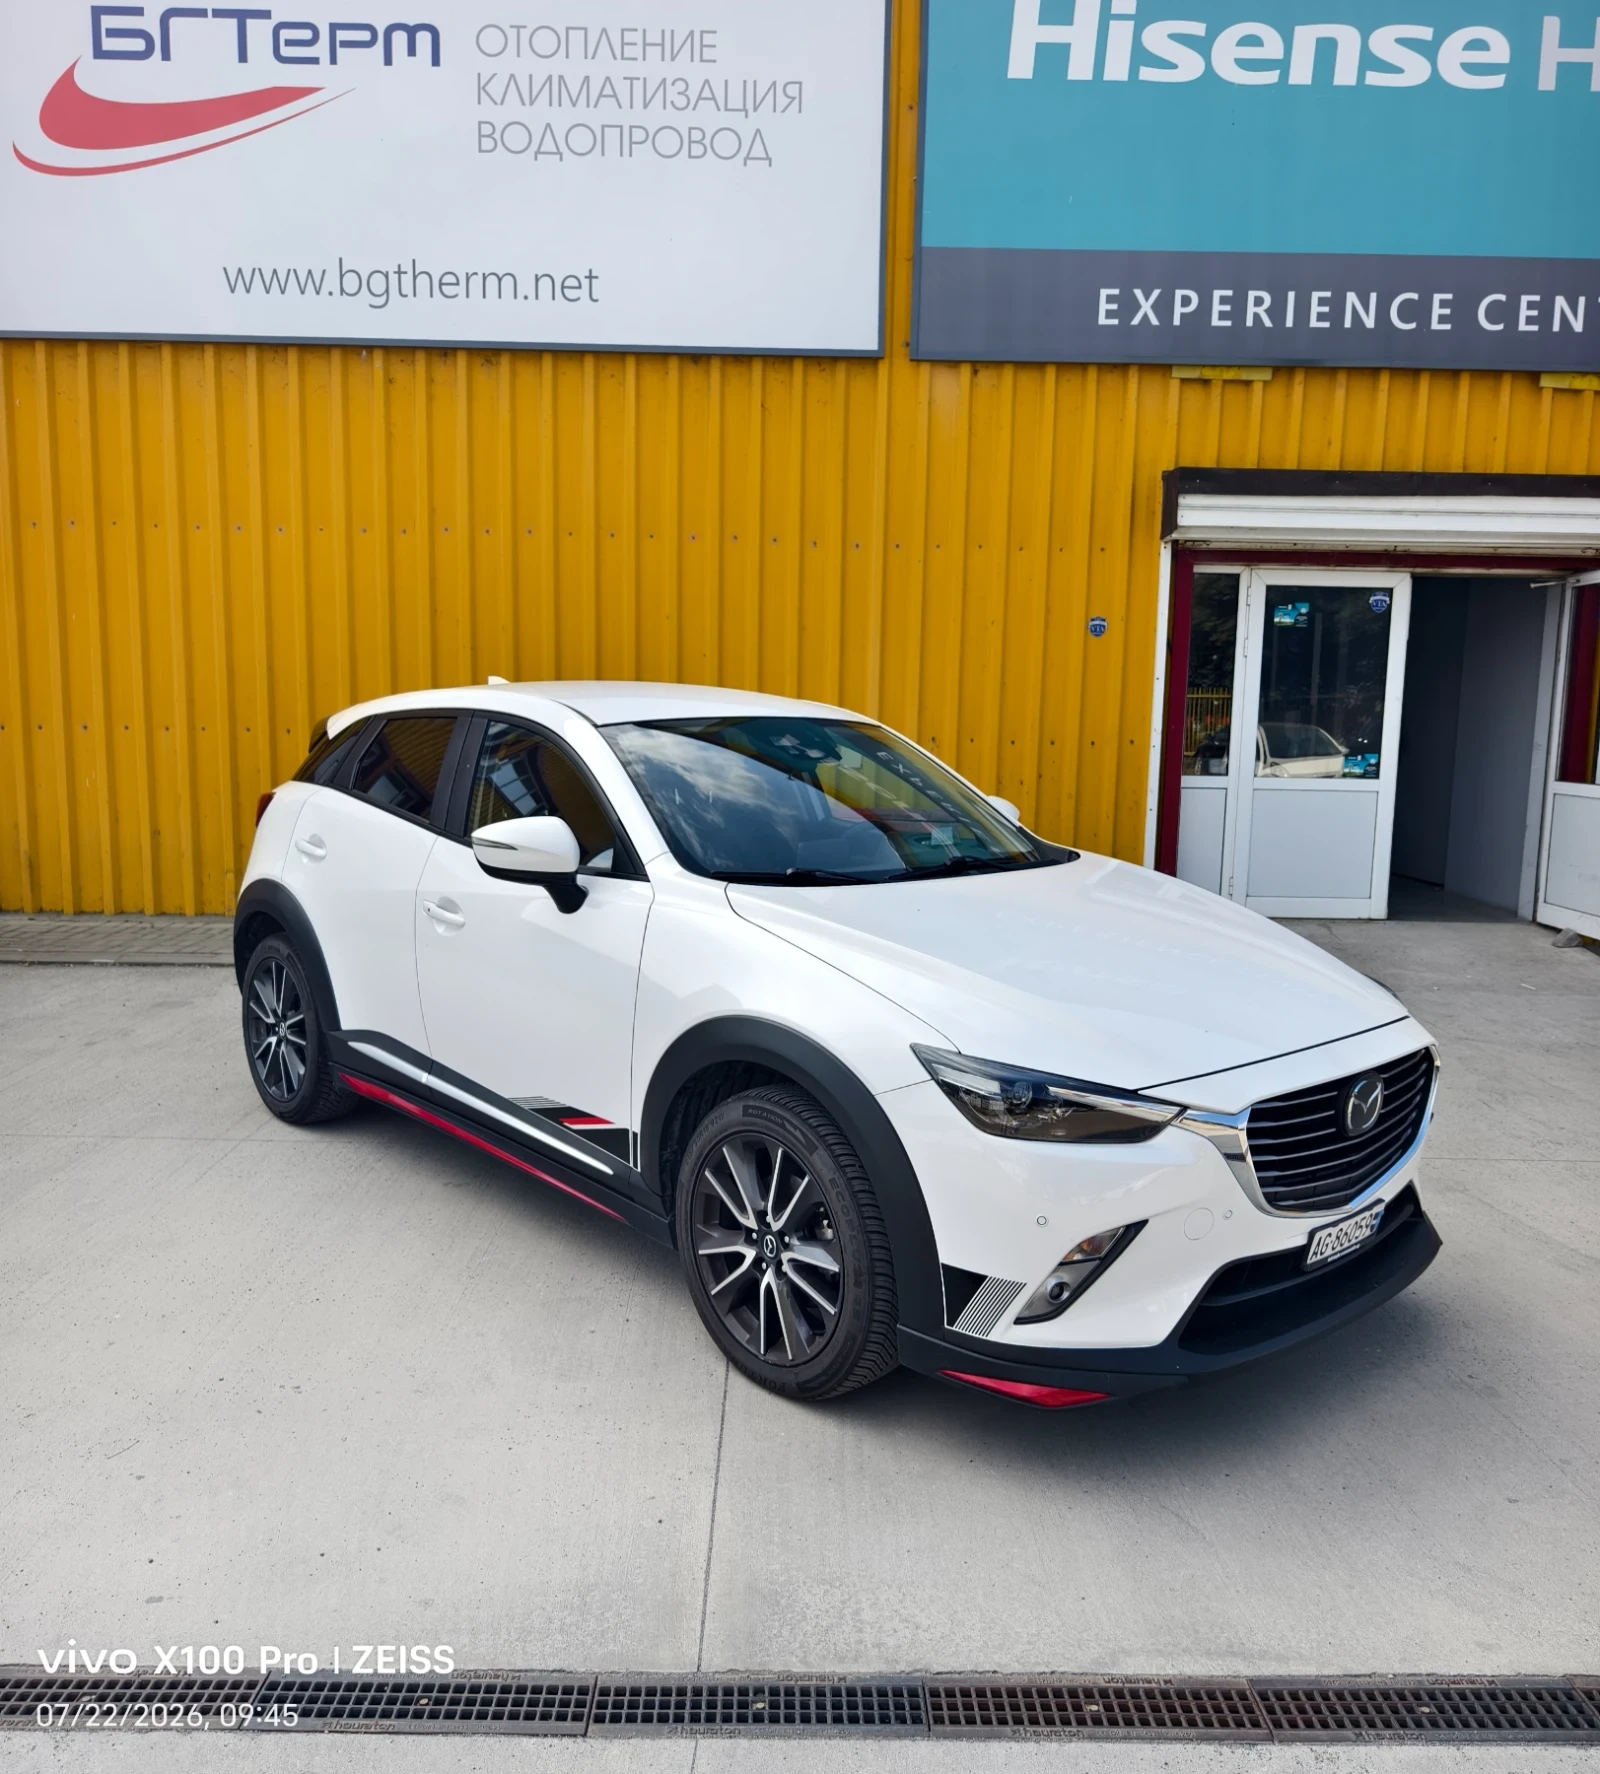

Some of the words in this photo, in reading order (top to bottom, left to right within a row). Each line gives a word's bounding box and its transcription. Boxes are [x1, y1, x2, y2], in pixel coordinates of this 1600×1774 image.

[475, 24, 718, 64] ОТОПЛЕНИЕ
[1007, 0, 1510, 89] Hisense
[476, 73, 803, 117] КЛИМАТИЗАЦИЯ
[477, 121, 773, 167] ВОДОПРОВОД
[223, 257, 600, 309] www.bgtherm.net
[1097, 288, 1454, 330] EXPERIENCE
[1477, 293, 1600, 333] CEN
[747, 1108, 783, 1124] ROTATION
